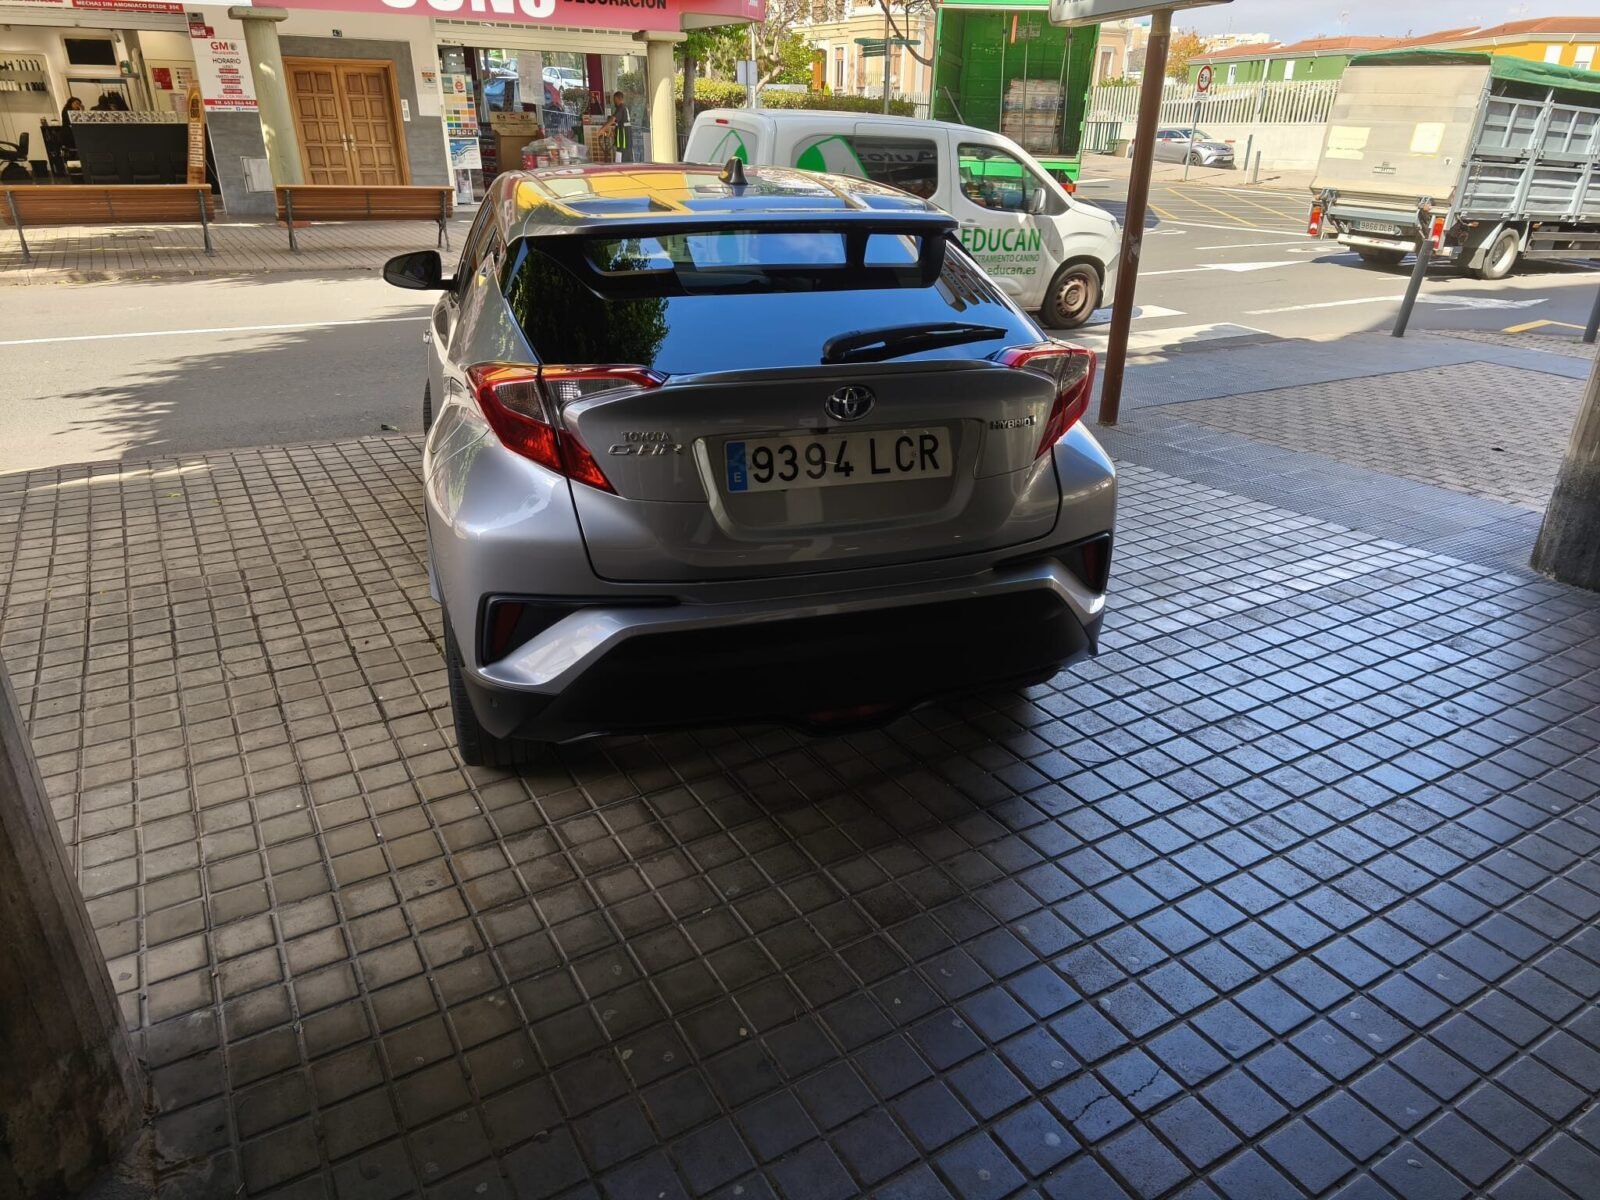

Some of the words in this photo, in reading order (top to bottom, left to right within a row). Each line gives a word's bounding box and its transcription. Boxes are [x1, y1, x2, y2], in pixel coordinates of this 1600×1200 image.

[211, 41, 229, 50] GM
[962, 228, 1041, 252] EDUCAN
[1015, 254, 1039, 262] CANINO
[990, 417, 1033, 430] HYBRID
[621, 431, 669, 441] TOYOTA
[751, 440, 854, 483] 9394
[869, 433, 940, 475] LCR
[734, 472, 742, 483] E
